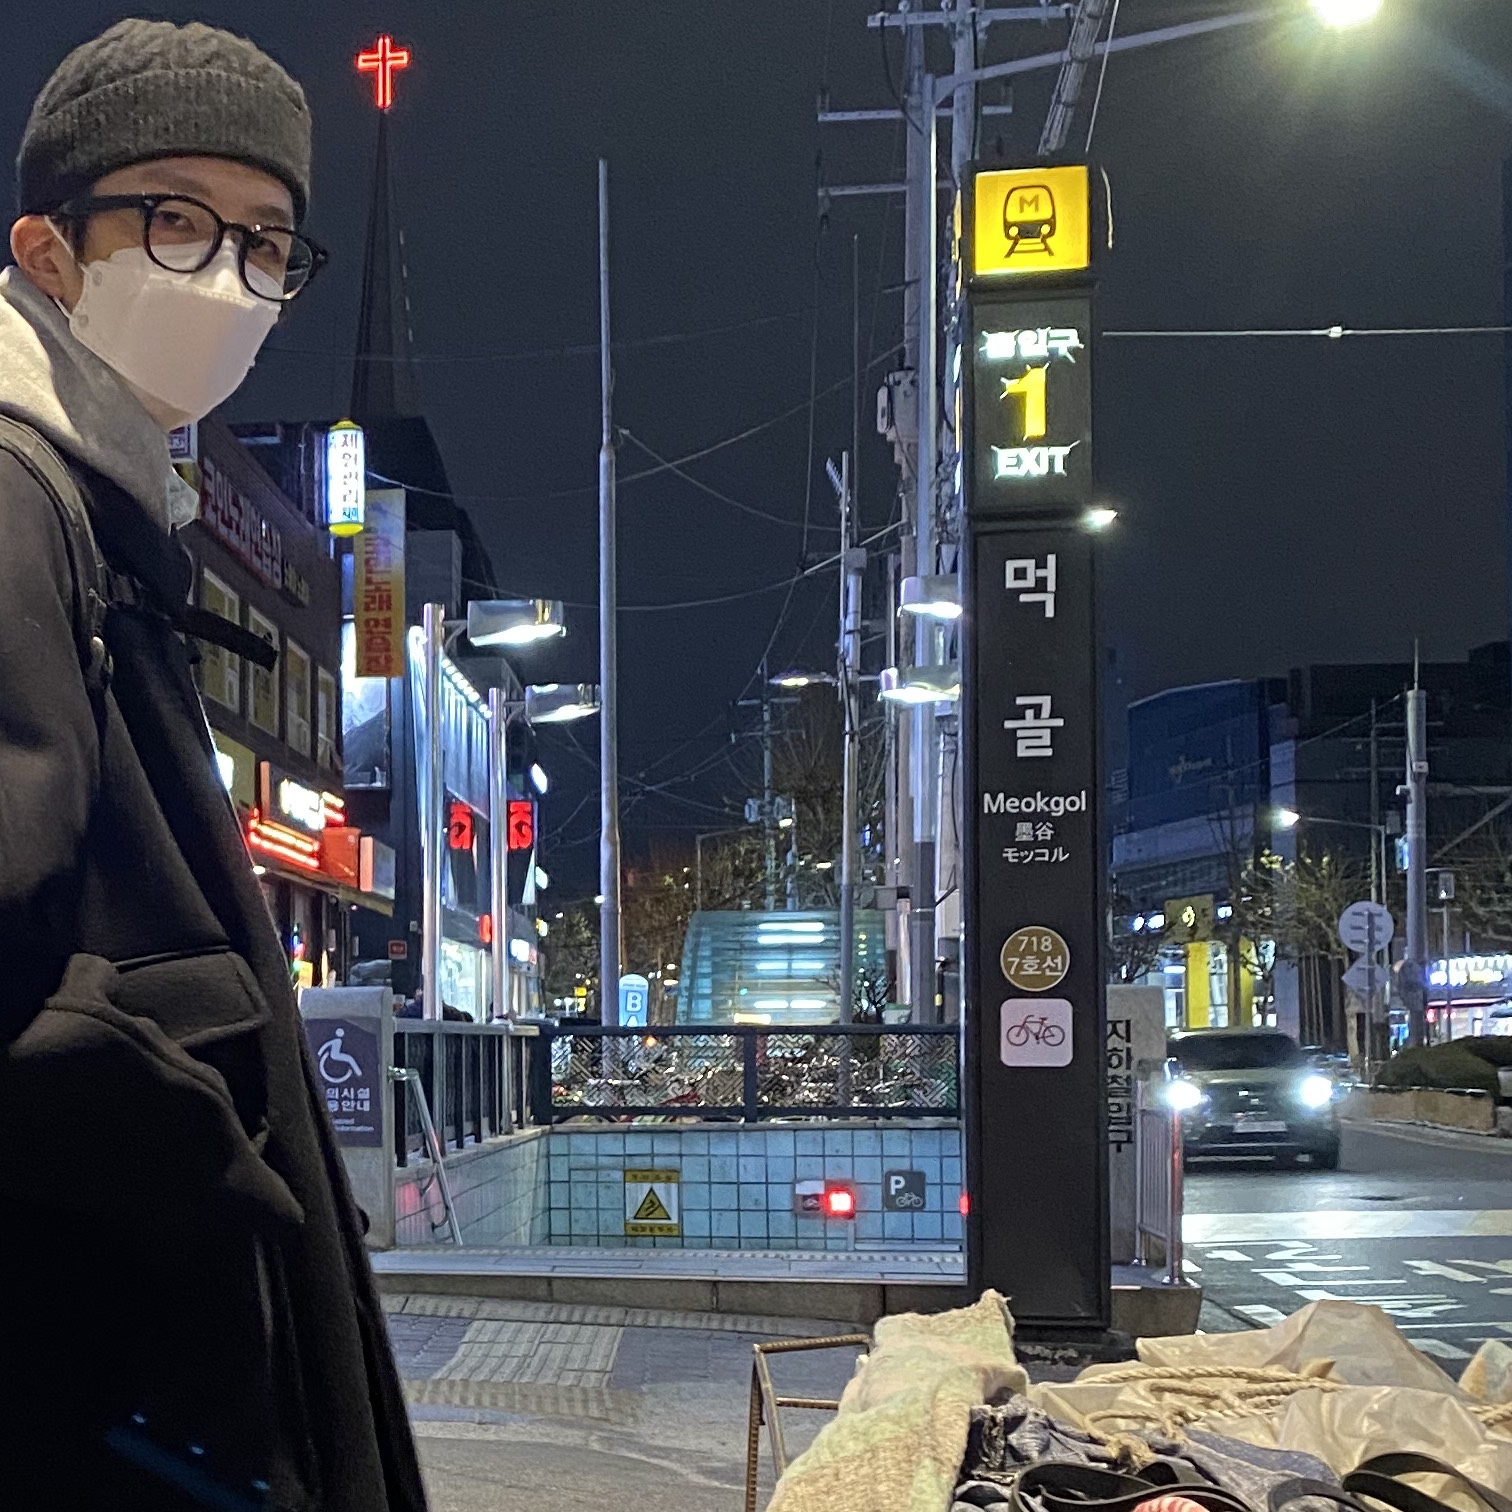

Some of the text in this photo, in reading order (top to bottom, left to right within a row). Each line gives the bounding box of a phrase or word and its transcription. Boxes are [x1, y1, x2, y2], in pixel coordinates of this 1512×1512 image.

[1005, 366, 1046, 438] 1
[995, 446, 1071, 476] EXIT
[983, 789, 1087, 817] Meokgol
[1001, 846, 1071, 864] モッコル
[1017, 935, 1054, 953] 718
[1006, 955, 1064, 977] 7호선
[890, 1175, 906, 1196] P
